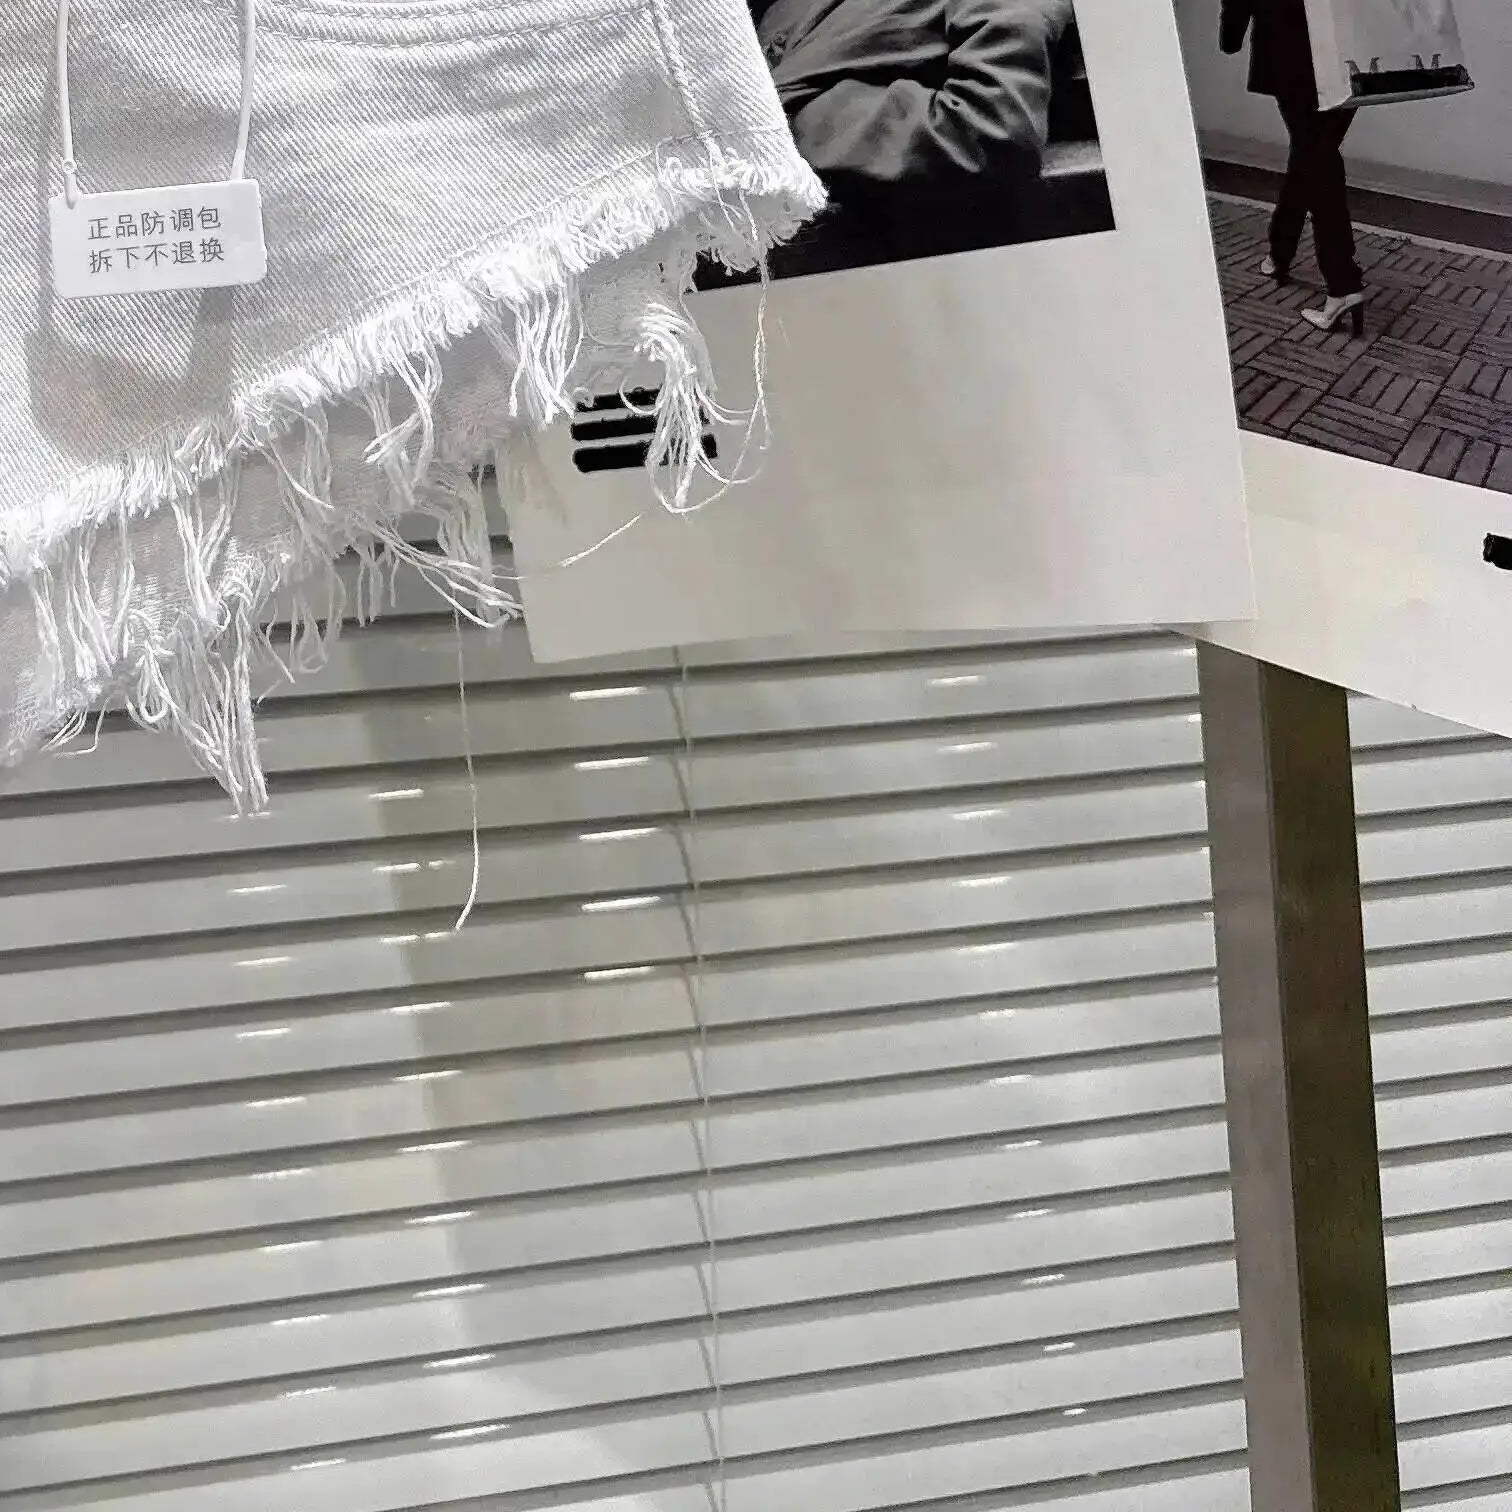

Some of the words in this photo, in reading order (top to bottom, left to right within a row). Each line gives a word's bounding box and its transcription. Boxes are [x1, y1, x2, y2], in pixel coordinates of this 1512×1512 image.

[87, 205, 222, 241] 正品防调包
[88, 236, 225, 274] 拆下不退换
